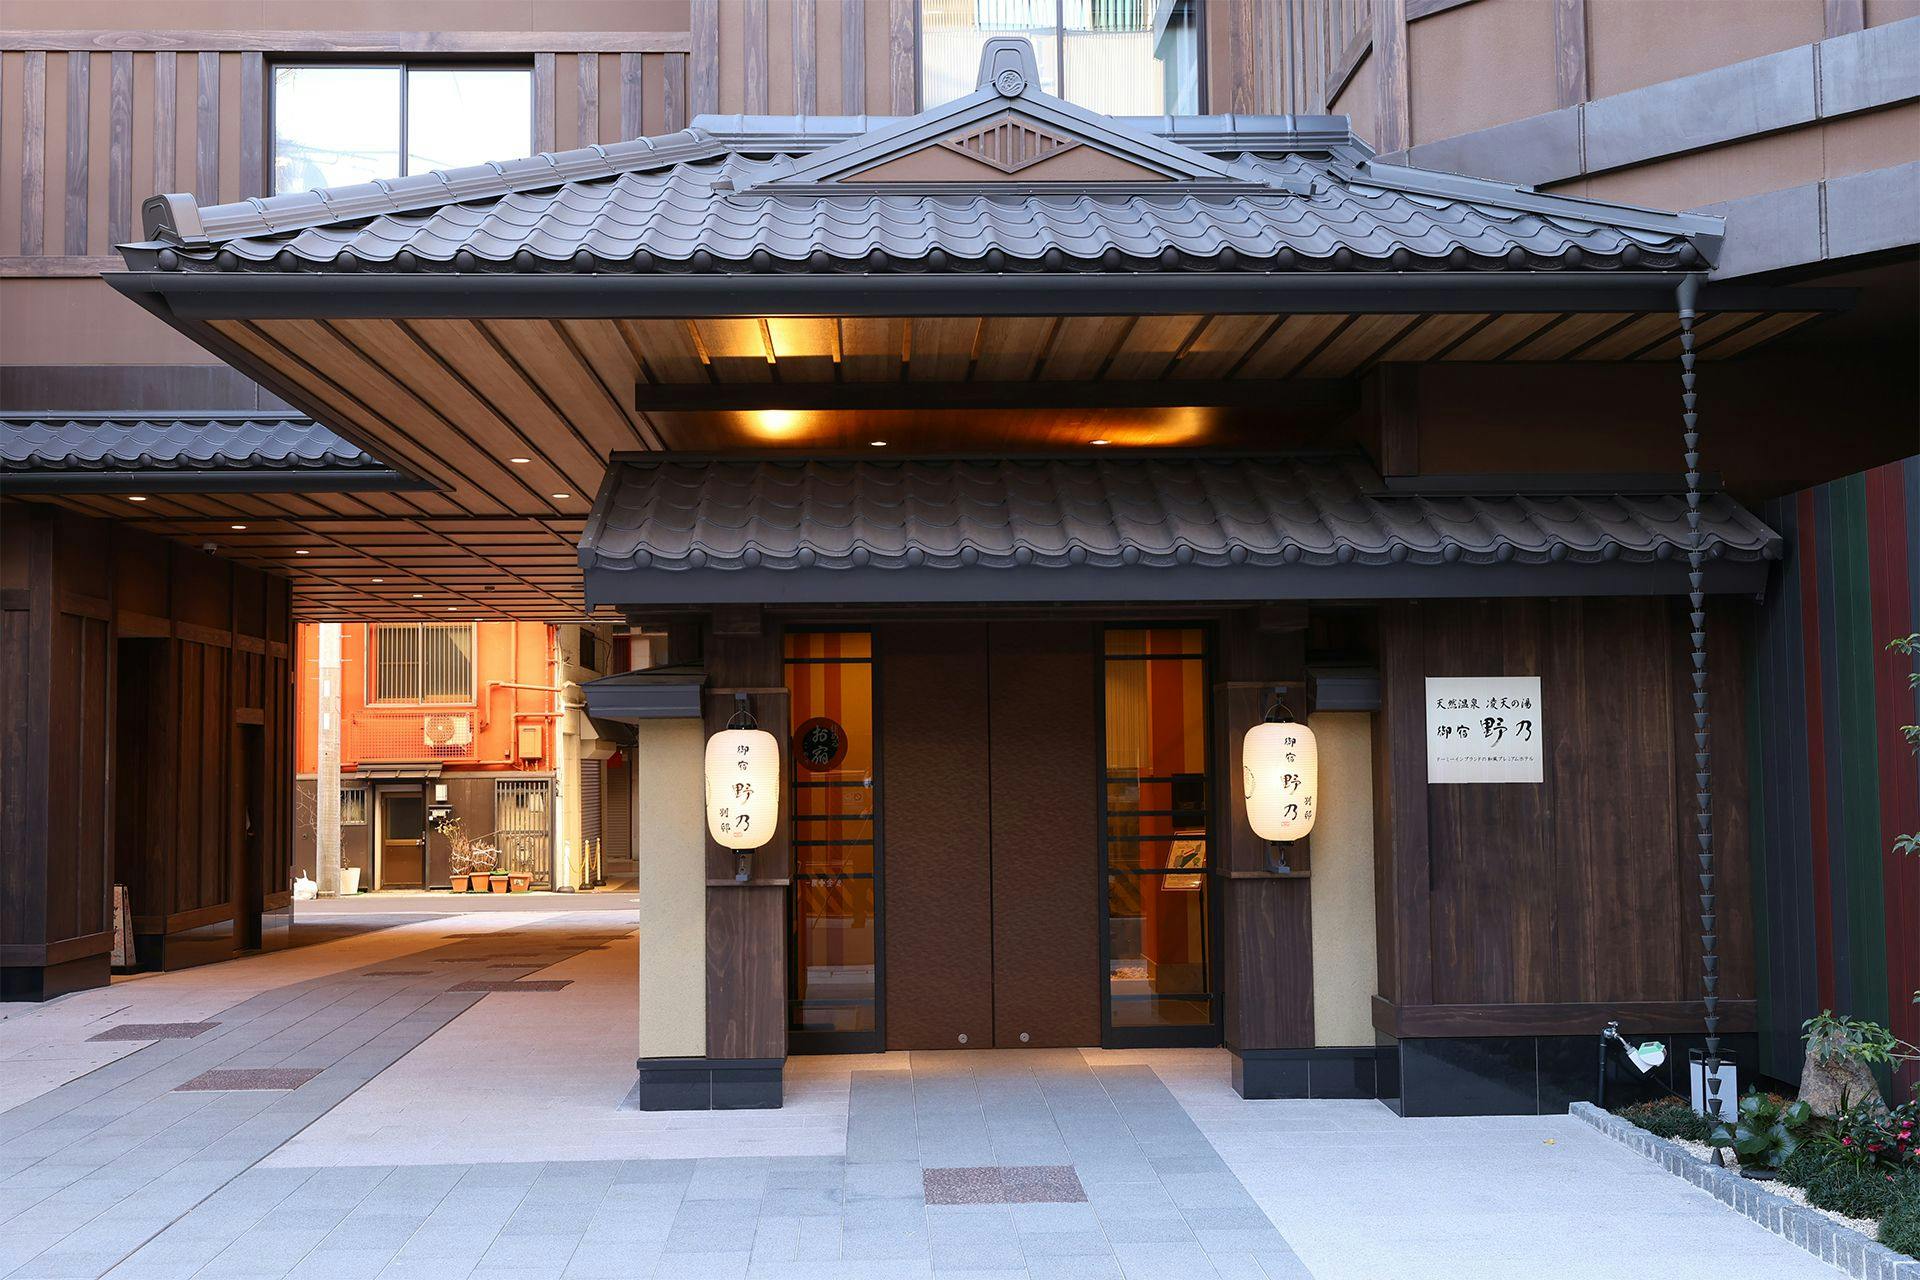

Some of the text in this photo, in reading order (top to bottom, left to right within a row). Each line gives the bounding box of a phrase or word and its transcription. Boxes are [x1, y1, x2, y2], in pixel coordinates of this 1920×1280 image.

[1437, 697, 1532, 710] 天然温泉 凌天の湯
[1437, 717, 1532, 748] 御宿 野乃
